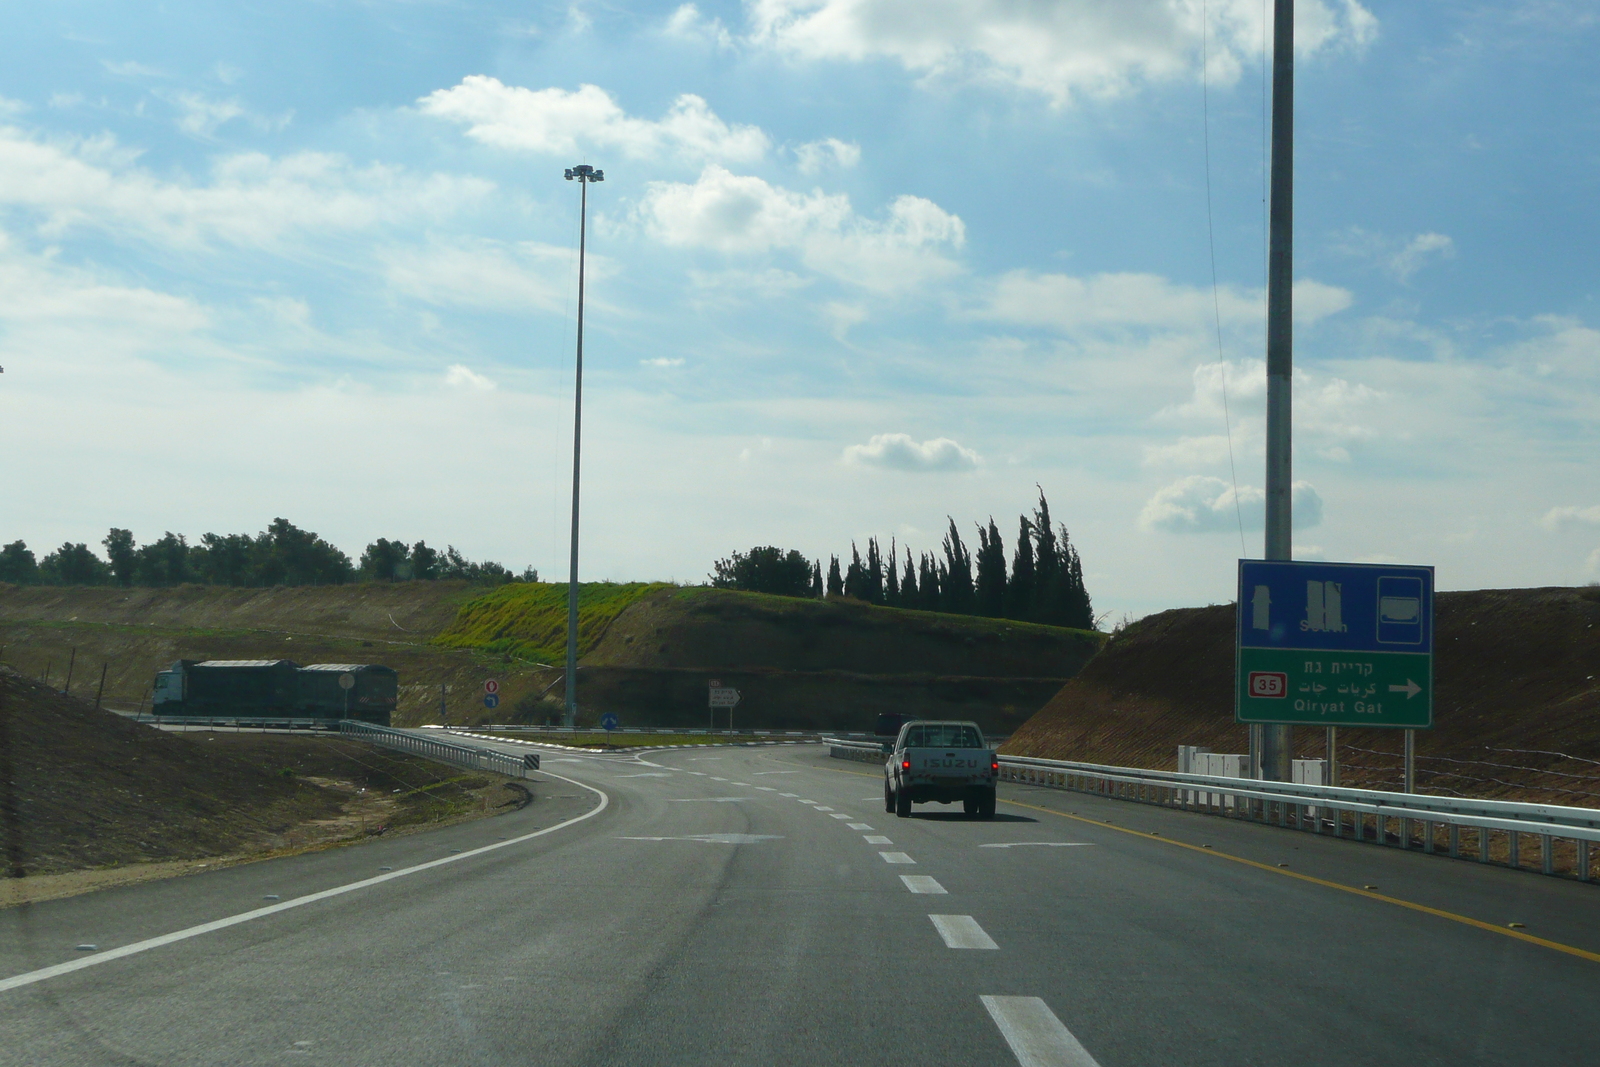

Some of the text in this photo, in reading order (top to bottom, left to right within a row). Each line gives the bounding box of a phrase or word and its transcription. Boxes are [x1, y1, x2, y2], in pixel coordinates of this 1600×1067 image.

[1304, 661, 1373, 677] קריית גת
[1259, 679, 1277, 691] 35
[1294, 698, 1382, 715] Qiryat Gat
[924, 759, 977, 768] ISUZU
